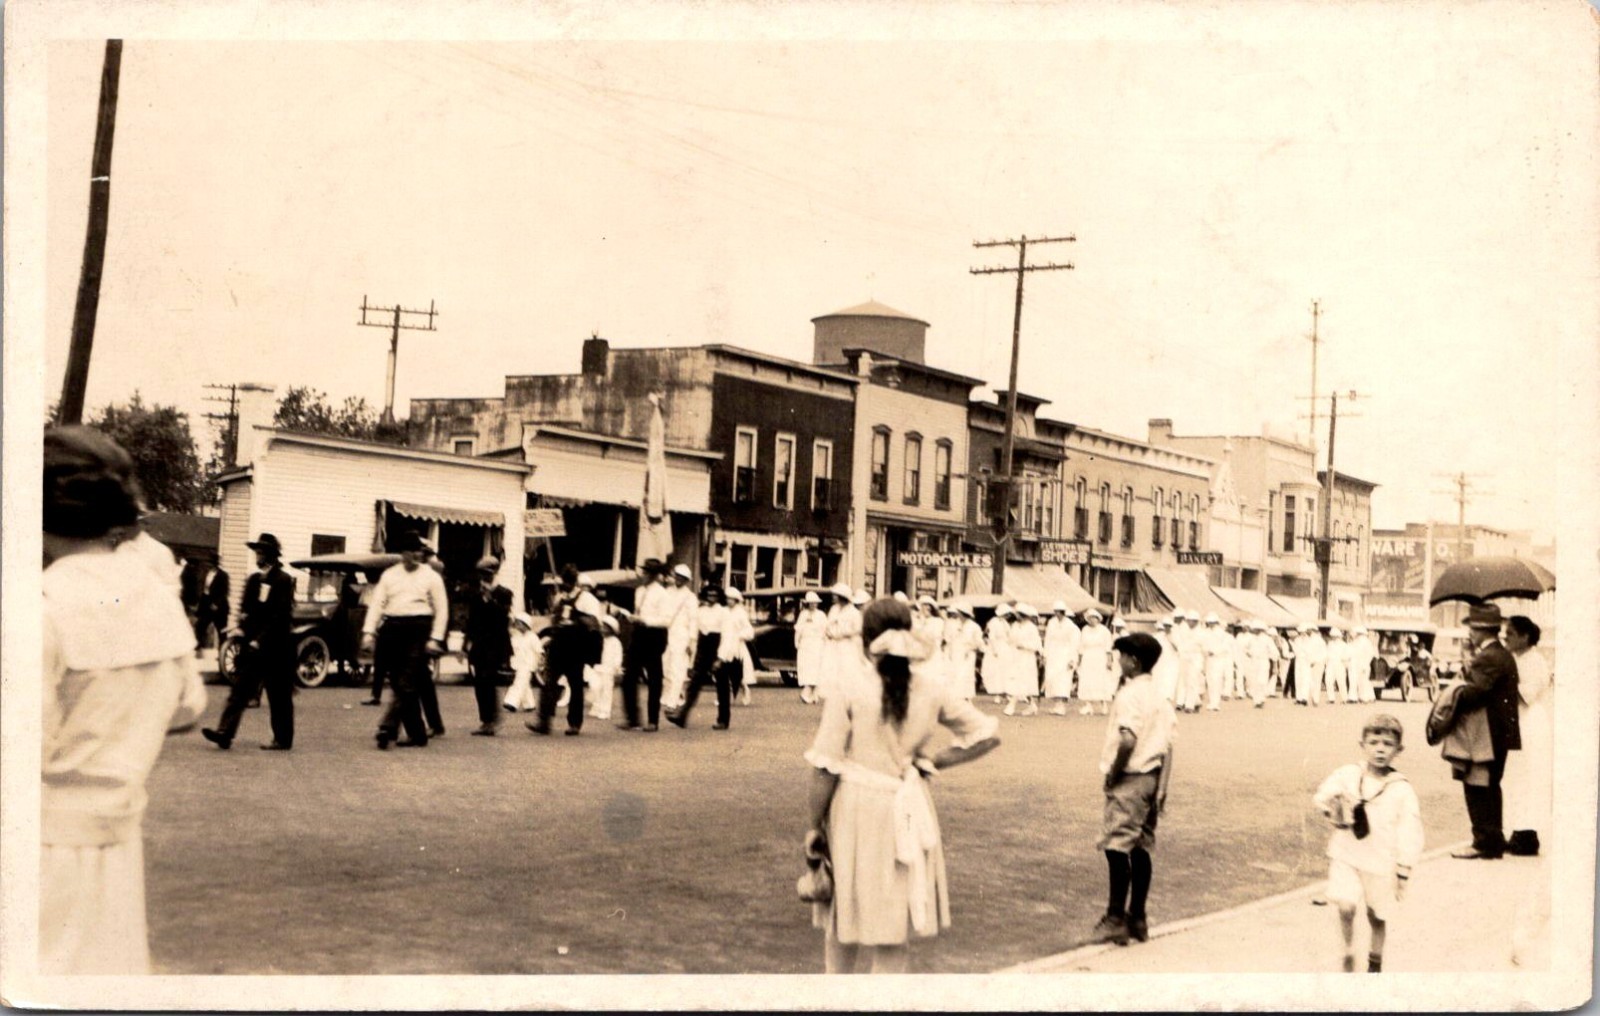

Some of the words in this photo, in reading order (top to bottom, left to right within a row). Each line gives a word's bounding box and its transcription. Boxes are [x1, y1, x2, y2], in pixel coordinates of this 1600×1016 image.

[900, 553, 992, 567] MOTORCYCLES
[1042, 550, 1087, 563] SHOES
[1180, 553, 1218, 565] BAKERY
